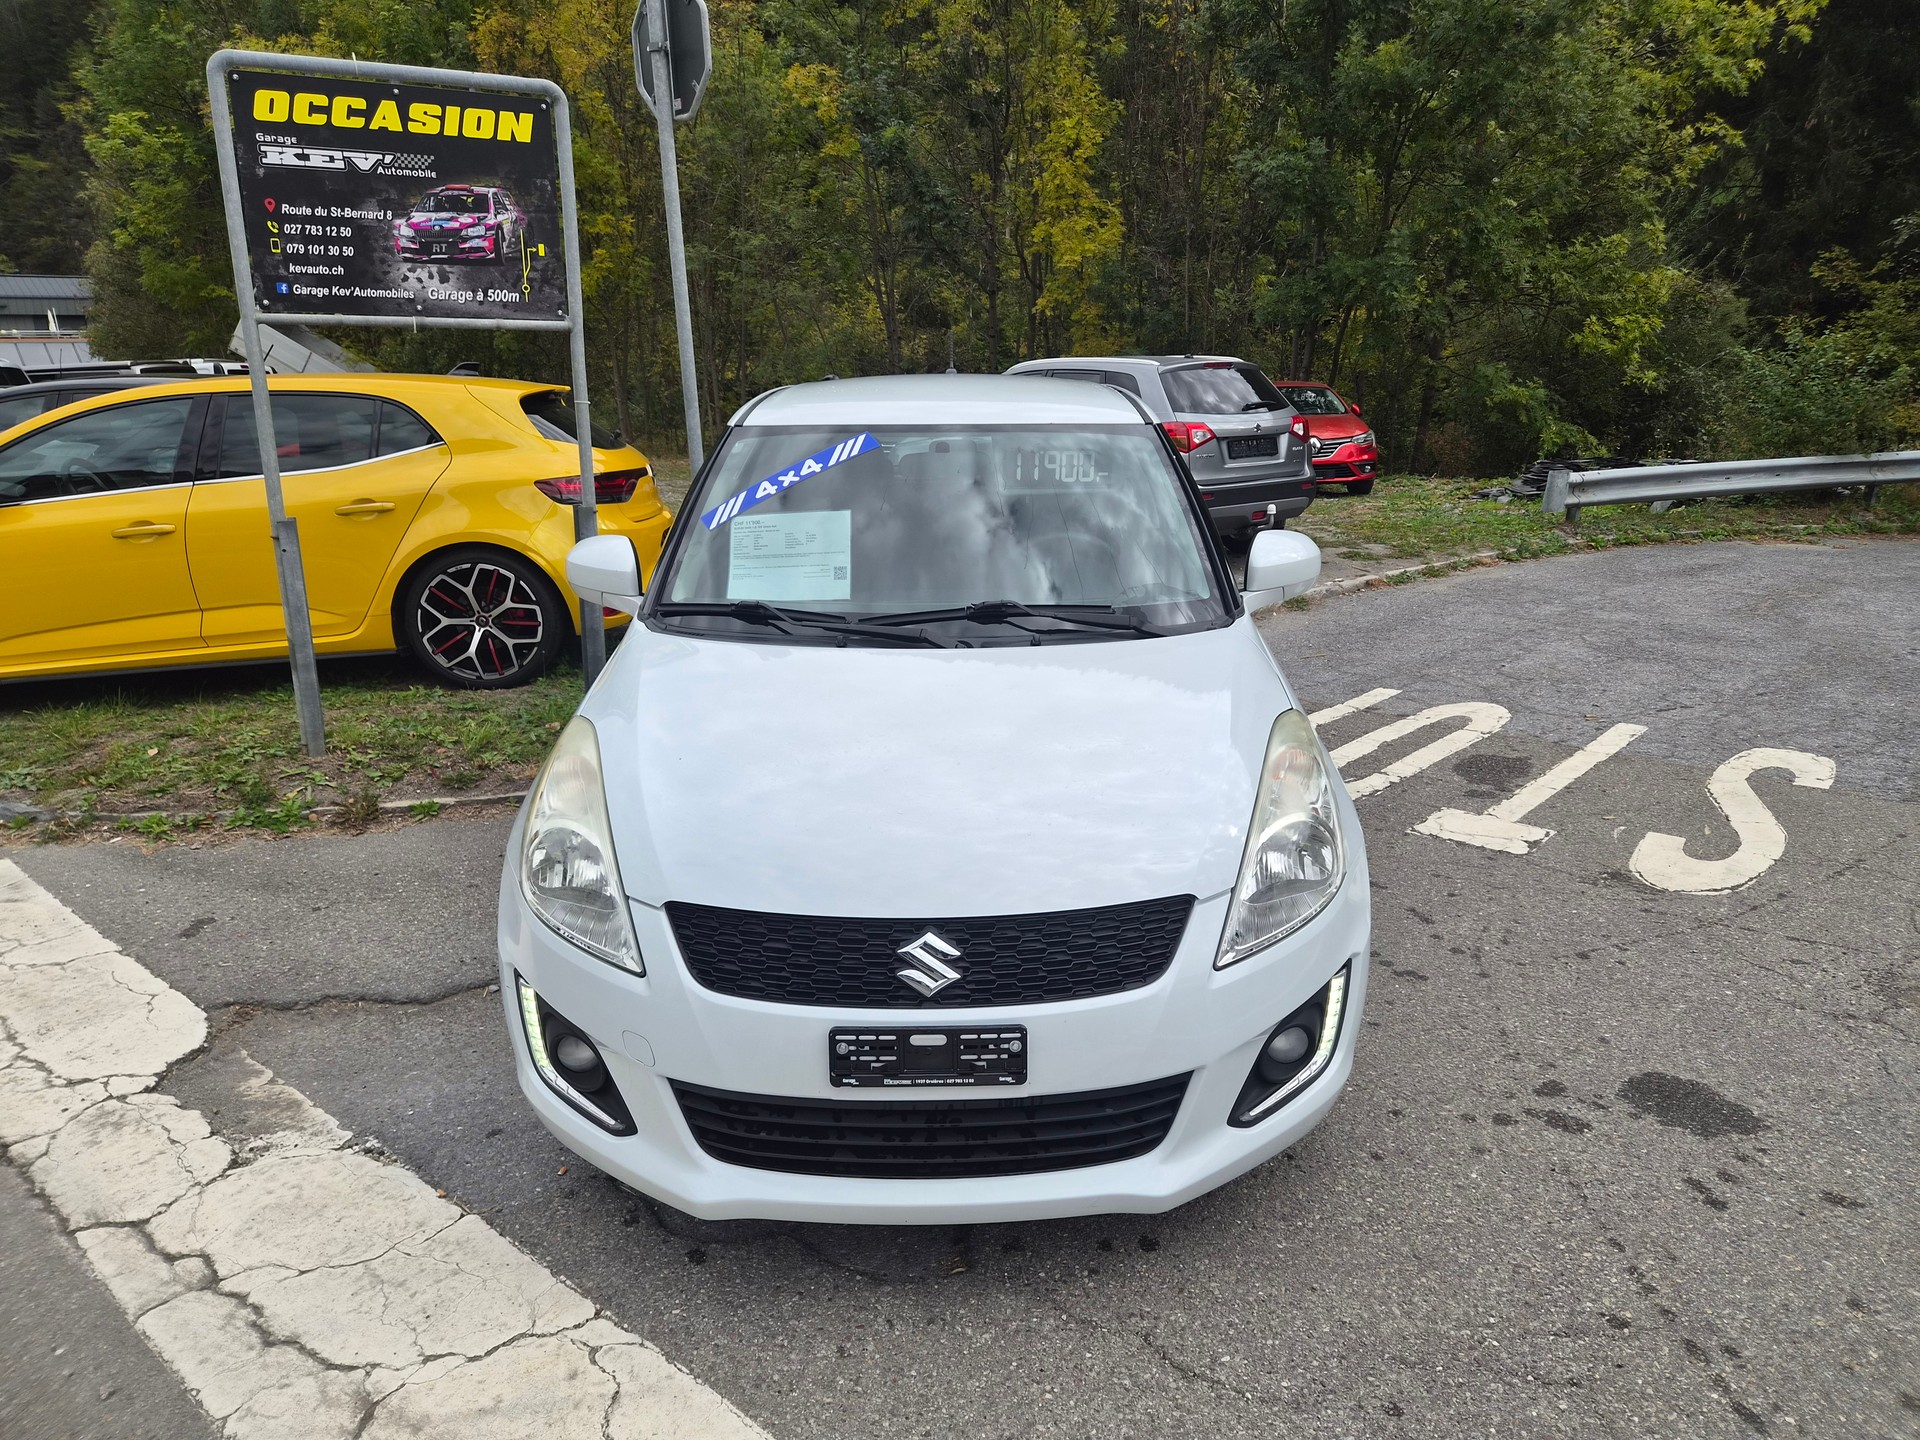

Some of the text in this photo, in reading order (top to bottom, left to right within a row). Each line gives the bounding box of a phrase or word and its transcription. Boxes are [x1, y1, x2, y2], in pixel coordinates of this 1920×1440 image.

[253, 89, 535, 143] OCCASION
[255, 132, 298, 145] Garage
[281, 204, 393, 221] Route du St-Bernard 8
[284, 224, 352, 238] 027 783 12 50
[286, 243, 354, 257] 079 101 30 50
[289, 263, 344, 276] kevauto.ch
[292, 284, 330, 297] Garage
[331, 286, 415, 299] Kev'Automobiles
[428, 287, 520, 303] Garage à 500m
